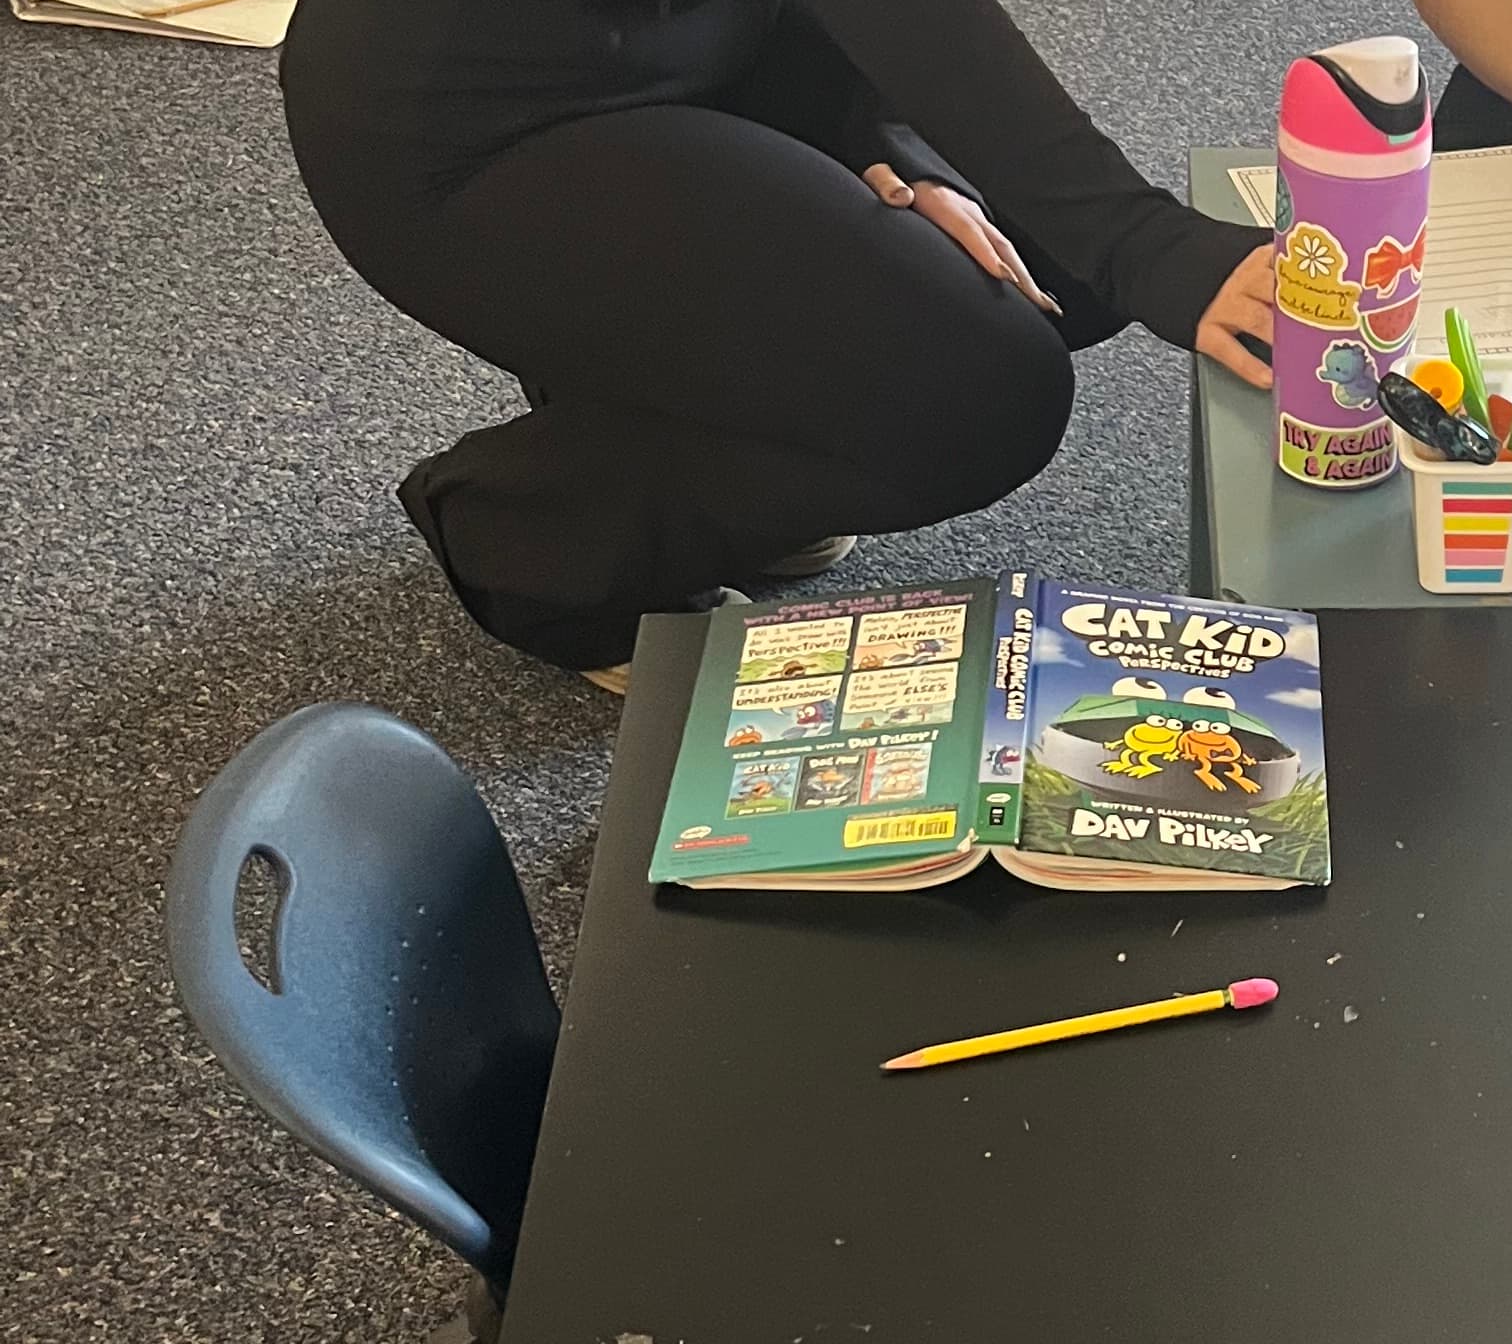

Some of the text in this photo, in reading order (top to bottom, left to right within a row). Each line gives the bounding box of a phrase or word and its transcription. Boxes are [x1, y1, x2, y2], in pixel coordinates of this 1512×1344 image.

[1283, 421, 1391, 455] TRY AGAIN
[1304, 456, 1391, 480] & AGAIN
[743, 614, 784, 626] WITH
[787, 612, 801, 621] A
[804, 608, 843, 619] NEW
[849, 603, 897, 615] POINT
[902, 598, 921, 608] OF
[777, 589, 944, 615] COMIC CLUB IS BACK
[1014, 607, 1033, 632] CAT
[1062, 603, 1172, 639] CAT
[1184, 649, 1255, 673] CLUB
[1006, 689, 1026, 721] CLUB
[848, 737, 877, 750] DAV
[743, 764, 766, 775] CAT
[1071, 808, 1150, 841] DAV
[1090, 800, 1249, 825] WRITTEN & ILLUSTRATED BY
